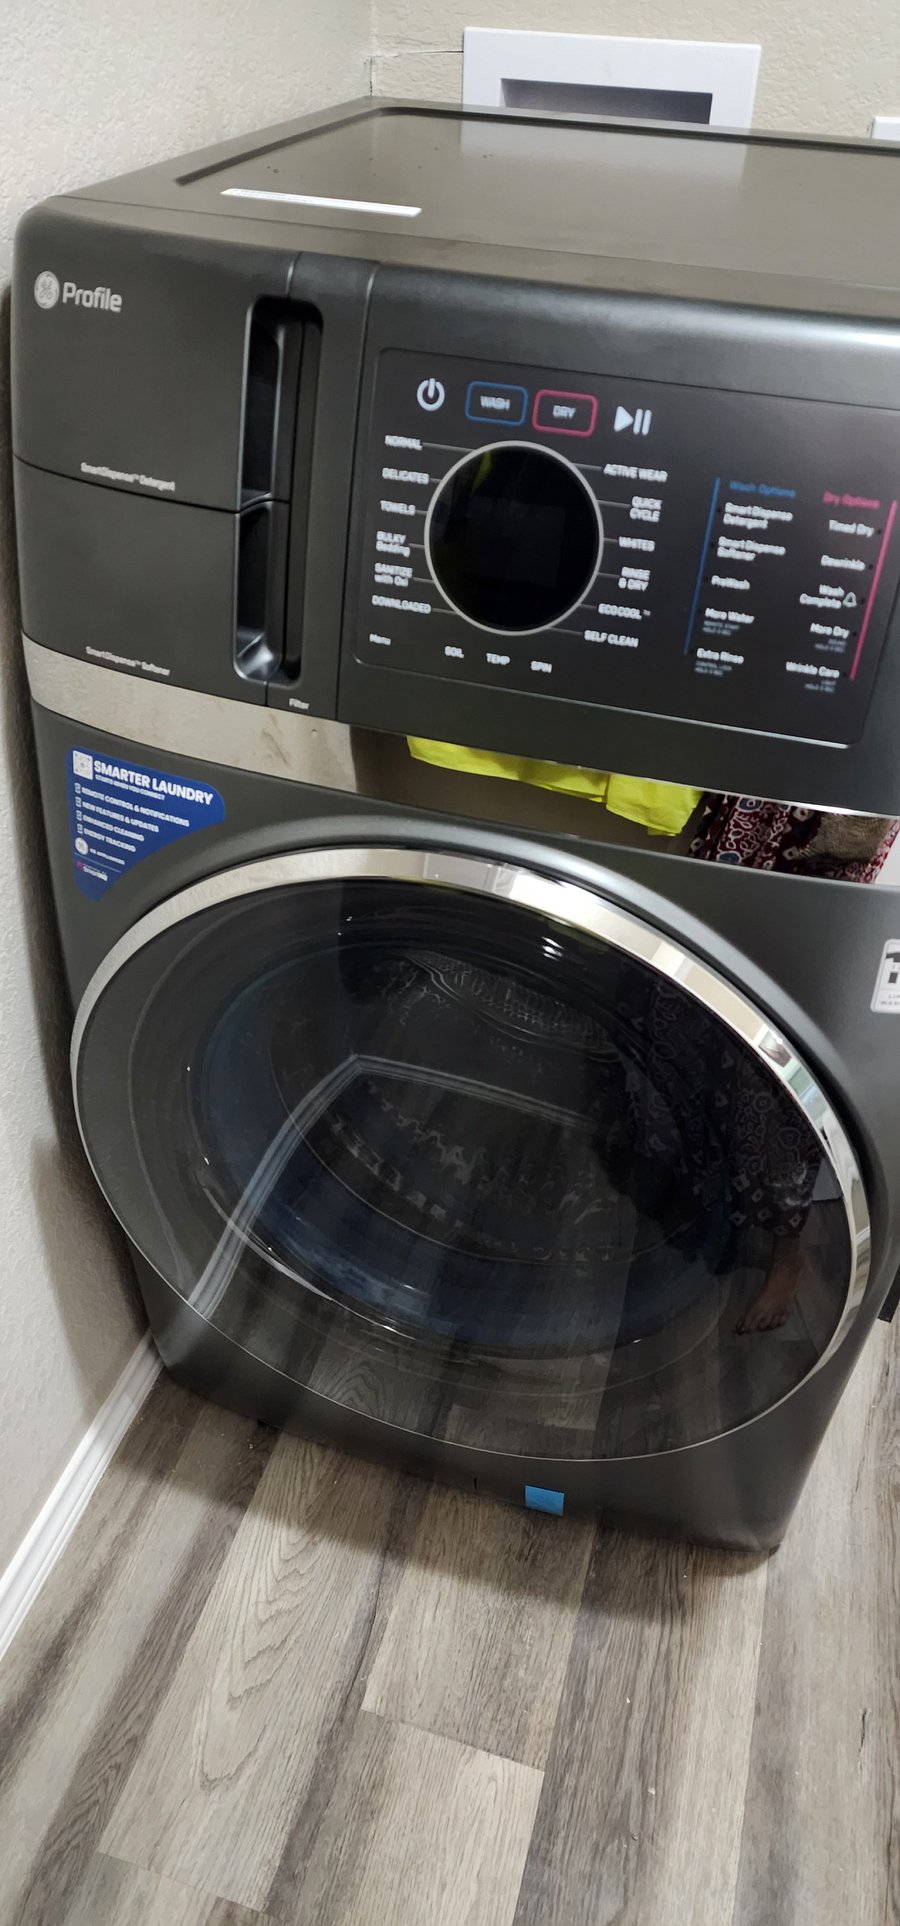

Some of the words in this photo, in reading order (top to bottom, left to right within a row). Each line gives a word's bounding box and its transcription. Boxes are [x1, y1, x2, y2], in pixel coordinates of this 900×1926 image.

[63, 282, 123, 313] Profile
[480, 396, 510, 410] WASH
[552, 405, 576, 419] DRY
[385, 435, 422, 450] NORMAL
[382, 467, 429, 484] DELICATES
[603, 463, 638, 479] ACTIVE
[638, 468, 668, 483] WEAR
[631, 496, 662, 511] QUICK
[823, 491, 840, 505] Dry
[380, 500, 416, 516] TOWELS
[629, 507, 660, 523] CYCLE
[376, 531, 407, 545] BULKY
[618, 536, 655, 552] WHITES
[375, 563, 413, 579] SANITIZE
[621, 566, 651, 581] RINSE
[627, 579, 649, 591] DRY
[372, 595, 432, 614] DOWNLOADED
[584, 630, 607, 643] SELF
[607, 632, 639, 648] CLEAN
[444, 646, 465, 659] SOIL
[486, 652, 511, 666] TEMP
[531, 660, 552, 673] SPIN
[94, 760, 150, 789] SMARTER
[152, 778, 214, 805] LAUNDRY
[81, 787, 105, 801] REMOTE
[105, 795, 134, 811] CONTROL
[140, 806, 190, 827] NOTIFICATIONS
[82, 801, 96, 812] NEW
[96, 804, 125, 822] FEATURES
[131, 818, 160, 833] UPDATES
[83, 814, 114, 833] ENHANCED
[114, 825, 145, 842] CLEANING
[83, 828, 106, 842] ENERGY
[106, 836, 137, 852] TRACKING
